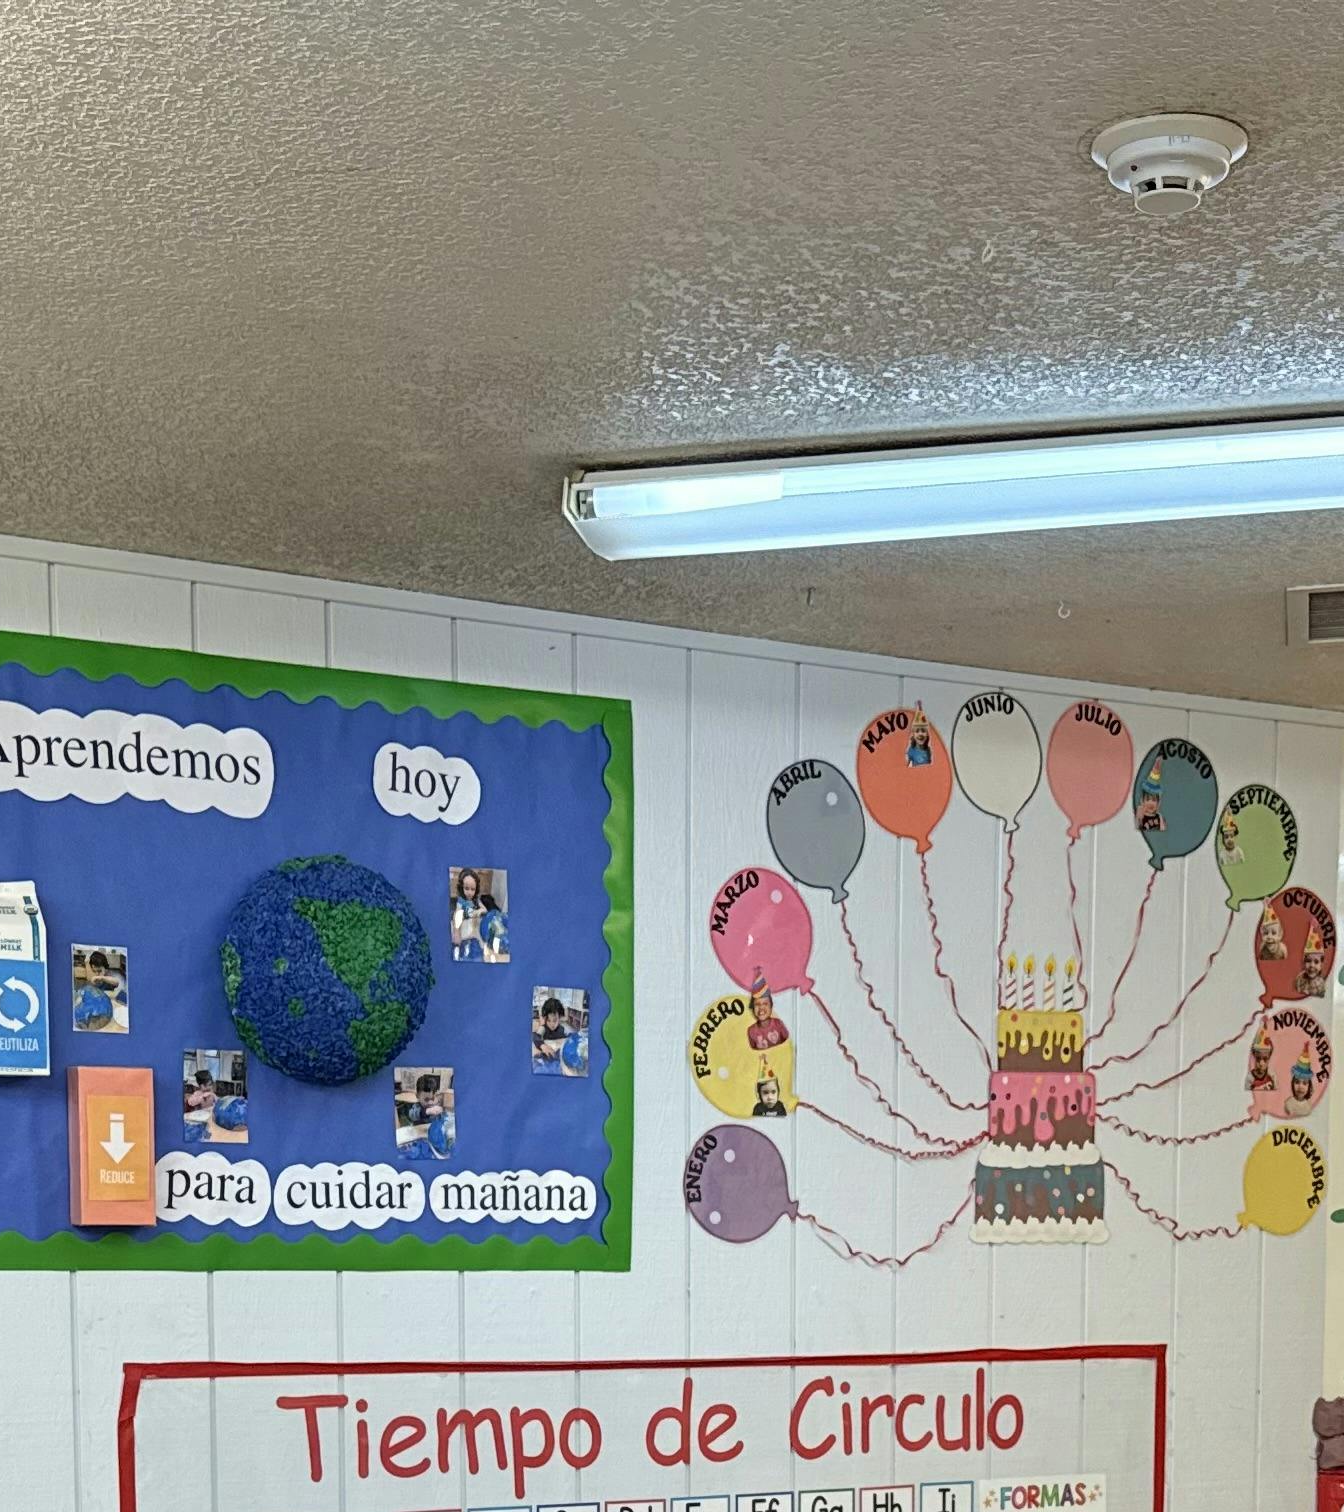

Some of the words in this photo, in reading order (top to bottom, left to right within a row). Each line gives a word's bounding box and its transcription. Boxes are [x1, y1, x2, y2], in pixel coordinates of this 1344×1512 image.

[861, 710, 909, 754] MAYO
[963, 695, 1015, 723] JUNIO
[1073, 703, 1122, 738] JULIO
[387, 752, 462, 811] hoy
[771, 762, 823, 807] ABRIL
[1155, 740, 1213, 780] AGOSTO
[1229, 788, 1297, 861] SEPTIEMBRE
[711, 869, 760, 935] MARZO
[1282, 890, 1337, 950] OCTUBRE
[695, 997, 746, 1078] FEBRERO
[1272, 1011, 1329, 1084] NOVIEMBRE
[99, 1168, 136, 1185] REDUCE
[164, 1167, 257, 1209] para
[285, 1168, 412, 1209] cuidar
[440, 1174, 589, 1213] mañana
[687, 1134, 719, 1203] ENERO
[1270, 1128, 1326, 1209] DICIEMBRE
[275, 1391, 603, 1499] Tiempo
[644, 1377, 744, 1468] de
[789, 1367, 1027, 1460] Circulo
[999, 1482, 1087, 1511] FORMAS
